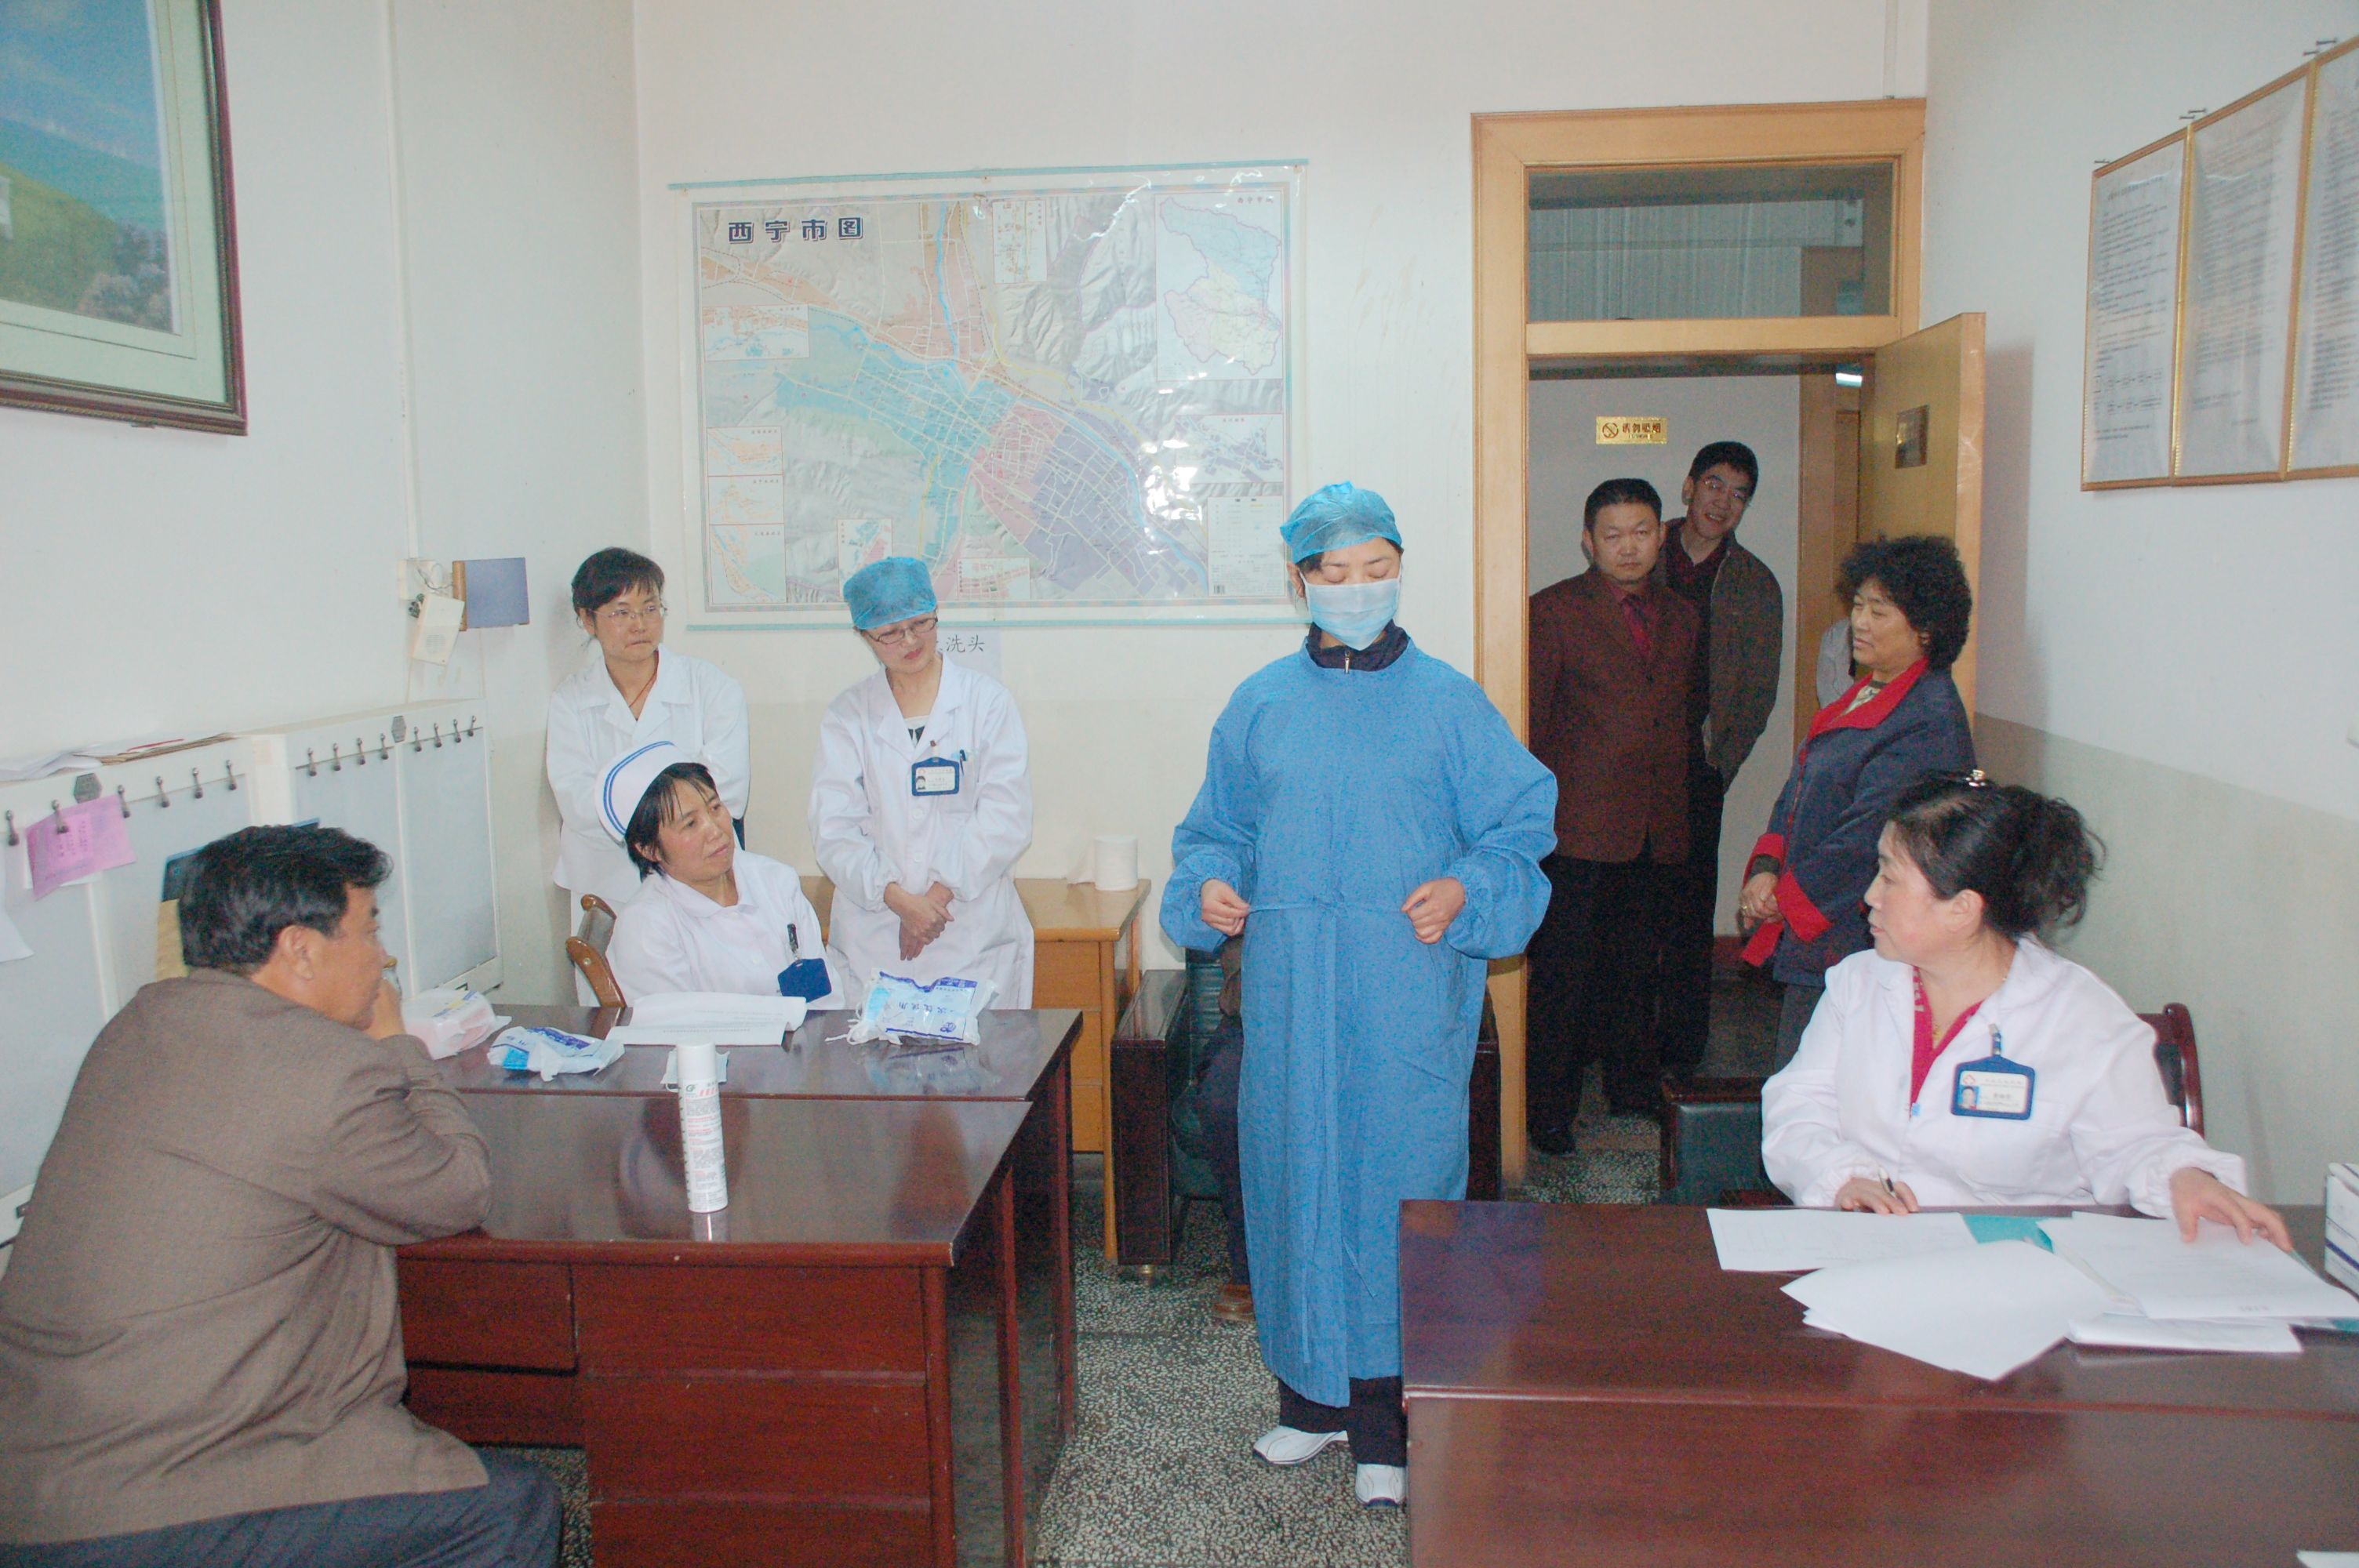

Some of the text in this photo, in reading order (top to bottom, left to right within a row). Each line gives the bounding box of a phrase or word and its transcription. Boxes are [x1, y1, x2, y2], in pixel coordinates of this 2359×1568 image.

[729, 217, 863, 243] 西宁市图
[936, 634, 985, 653] 洗头
